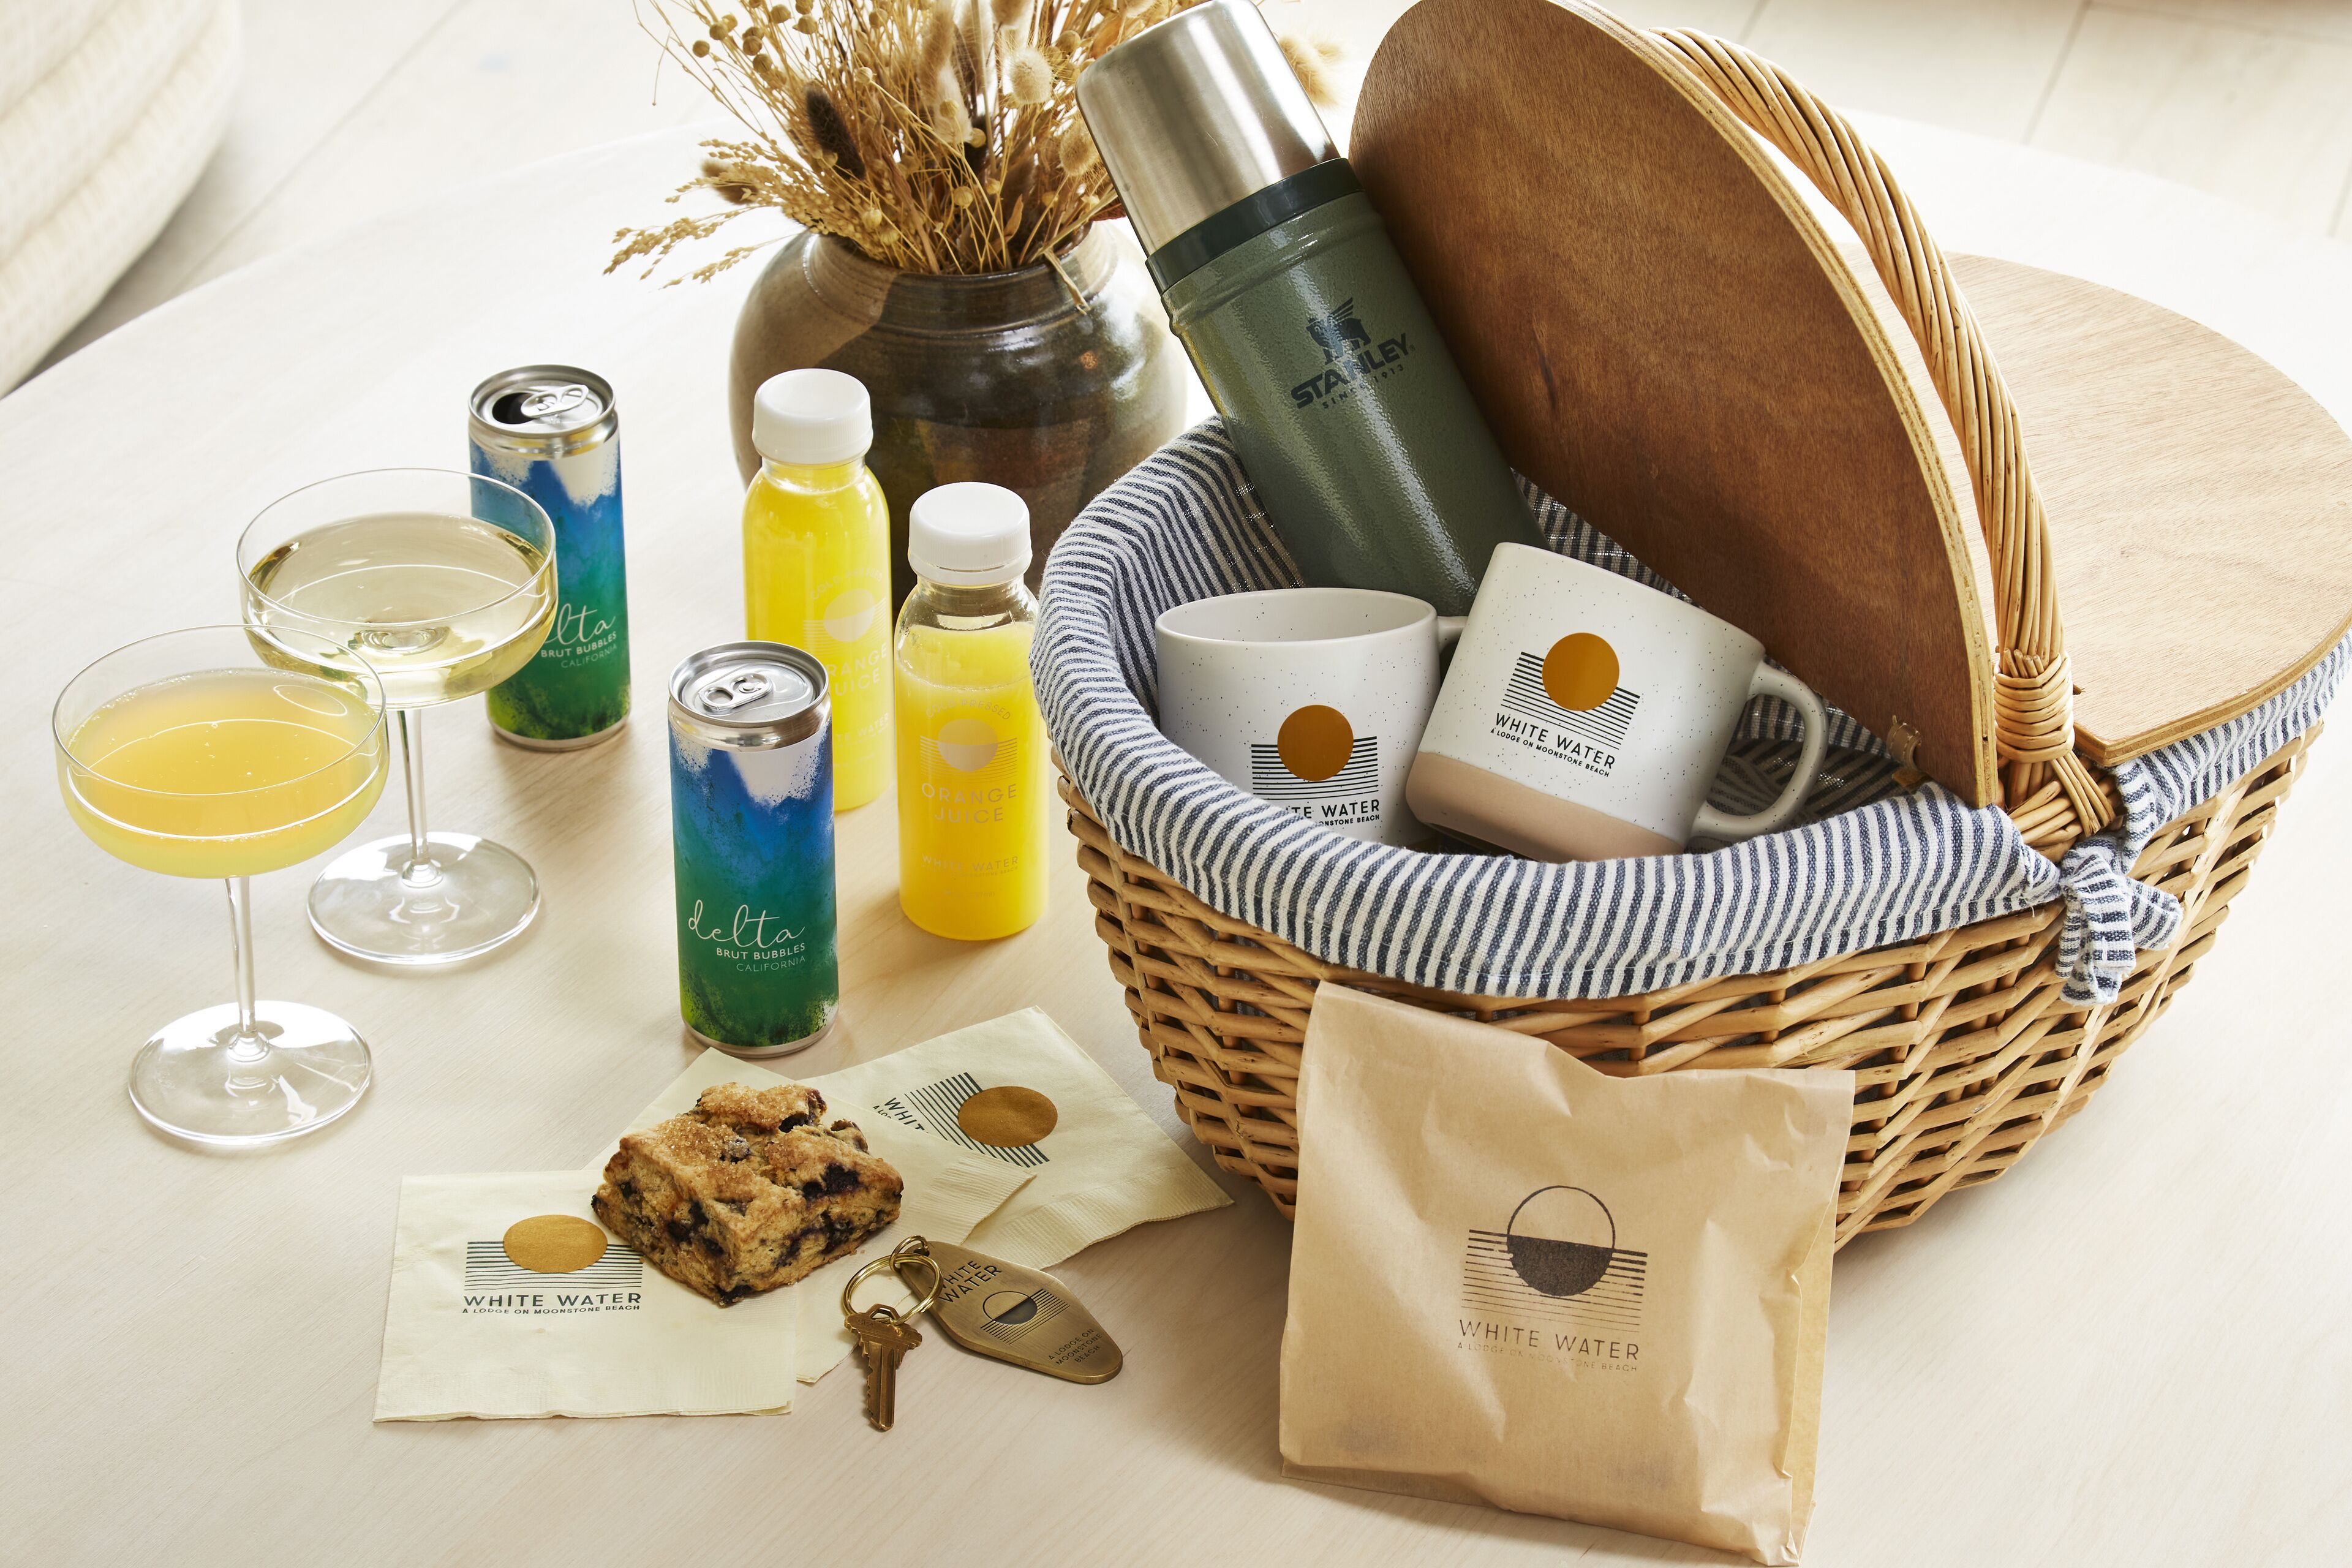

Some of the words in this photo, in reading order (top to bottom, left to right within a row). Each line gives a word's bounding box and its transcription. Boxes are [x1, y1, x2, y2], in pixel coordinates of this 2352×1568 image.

[1291, 333, 1409, 409] STANLEY
[1322, 382, 1365, 409] SINC
[1374, 364, 1404, 383] 1913
[545, 603, 616, 645] lta
[540, 648, 572, 658] BRUT
[576, 631, 617, 655] BUBBLES
[560, 644, 617, 668] CALIFORNIA
[826, 641, 887, 677] RANGE
[960, 699, 1011, 720] PRESSED
[1496, 712, 1549, 743] WHITE
[1556, 734, 1616, 769] WATER
[1496, 730, 1521, 743] LODGE
[1523, 739, 1534, 748] ON
[1535, 744, 1583, 767] MOONSTONE
[1585, 763, 1610, 778] BEACH
[921, 783, 1017, 804] ORANGE
[934, 807, 1003, 824] JUICE
[1319, 818, 1354, 826] NSTONE
[1356, 814, 1380, 823] BEACH
[1321, 799, 1381, 818] WATER
[971, 856, 1019, 872] WATER
[688, 899, 805, 948] delta
[716, 947, 748, 960] BRUT
[753, 942, 805, 960] BUBBLES
[736, 956, 806, 972] CALIFORNIA
[884, 1097, 929, 1133] WHIT
[938, 1265, 1002, 1303] WATER
[464, 1294, 544, 1307] WHITE
[556, 1292, 642, 1306] WATER
[1054, 1337, 1082, 1355] LODGE
[1082, 1329, 1095, 1338] ON
[1055, 1333, 1102, 1365] MOONSTONE
[1459, 1319, 1540, 1348] WHITE
[1555, 1333, 1640, 1360] WATER
[1074, 1345, 1101, 1363] BEACH
[1602, 1363, 1637, 1372] BEACH
